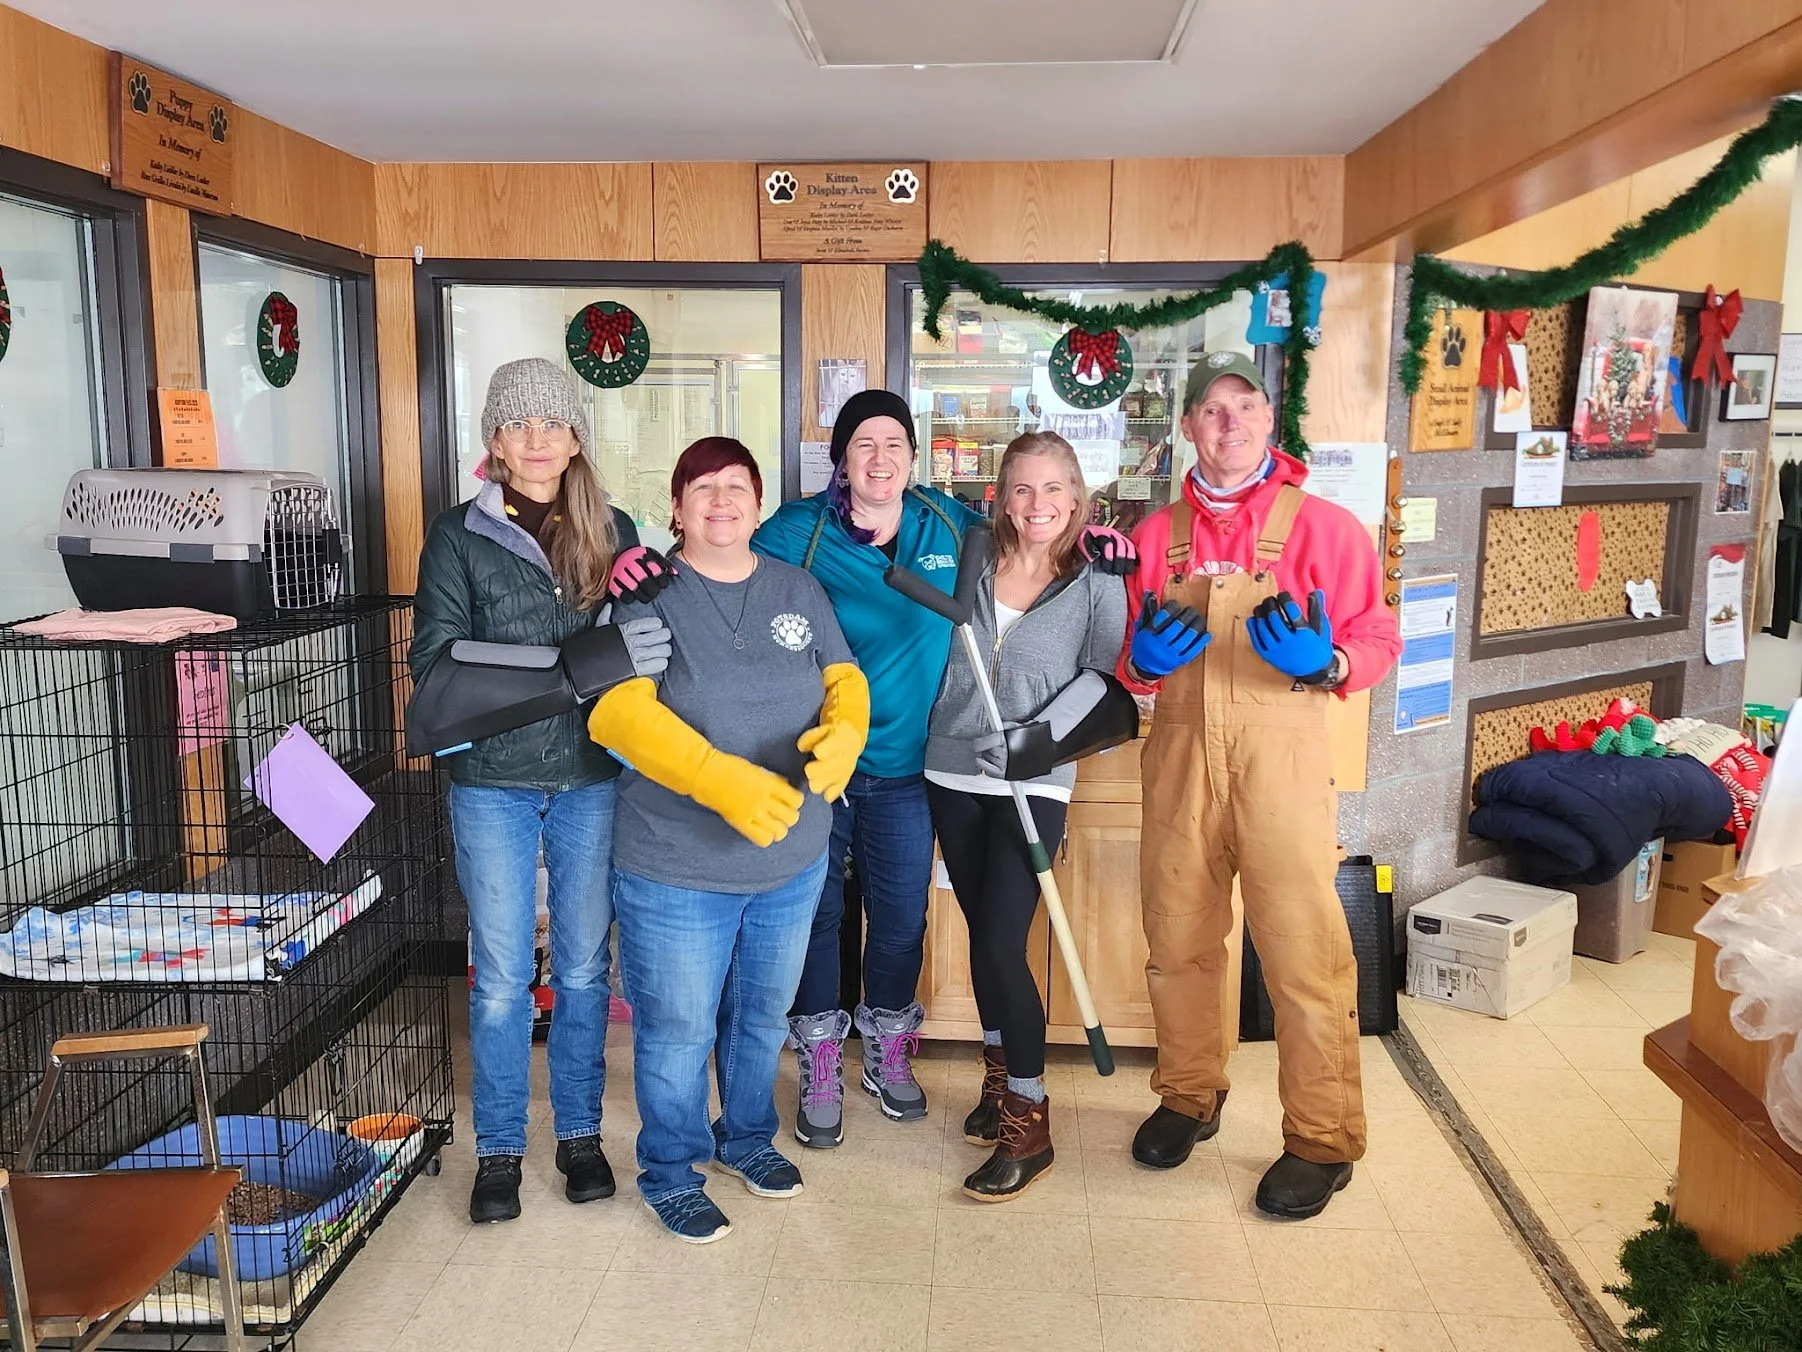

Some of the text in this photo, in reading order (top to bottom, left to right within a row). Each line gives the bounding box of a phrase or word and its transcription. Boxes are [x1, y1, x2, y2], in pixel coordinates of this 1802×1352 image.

[169, 89, 193, 114] Puppy
[156, 101, 205, 132] Display Area
[159, 133, 167, 147] In
[168, 137, 194, 160] Memory
[825, 172, 859, 183] Kitten
[807, 184, 878, 197] Display Area
[819, 200, 865, 211] In Memory of
[831, 238, 844, 246] Gift
[770, 613, 810, 628] POTSDAM
